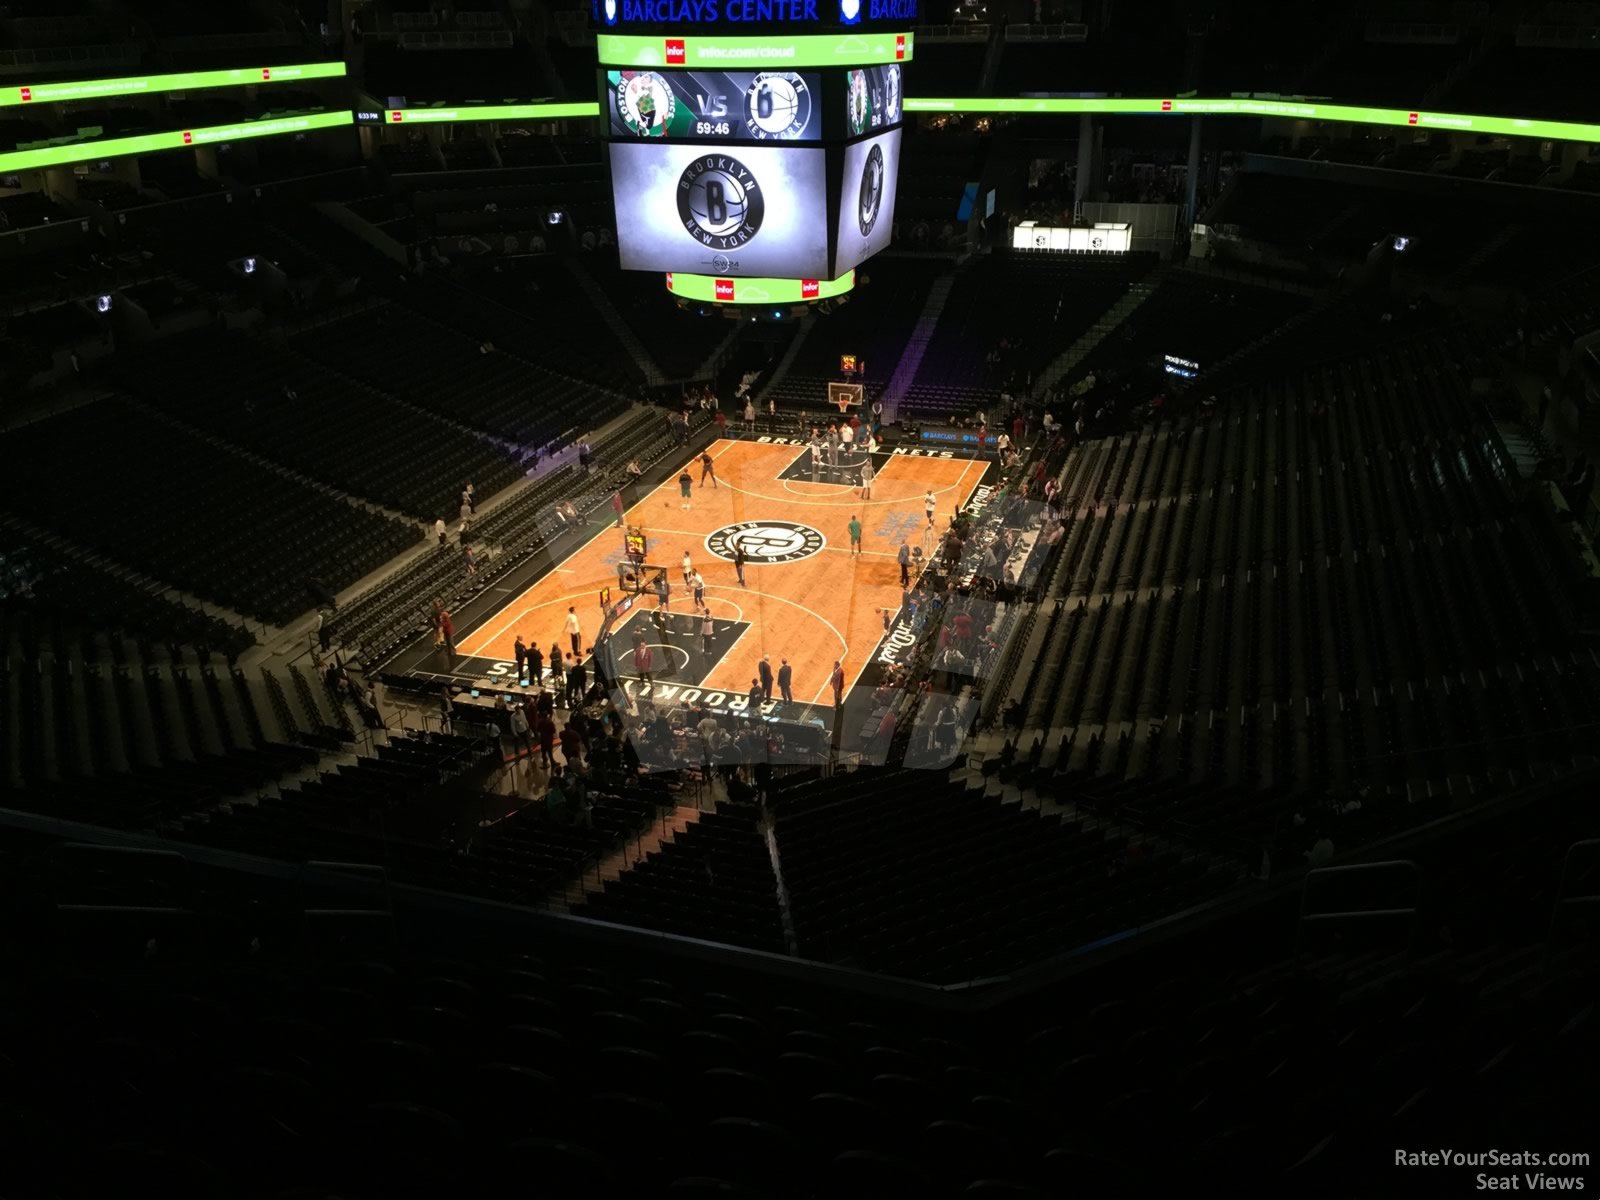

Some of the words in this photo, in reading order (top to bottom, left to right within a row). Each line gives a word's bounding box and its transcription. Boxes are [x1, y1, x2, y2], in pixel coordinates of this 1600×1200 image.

[623, 0, 718, 22] BARCLAYS
[726, 0, 819, 21] CENTER
[666, 46, 684, 55] infor
[618, 78, 634, 122] BOSTON
[697, 94, 728, 117] VS
[697, 122, 730, 135] 59:46
[747, 119, 767, 139] NEW
[681, 157, 756, 191] BROOKLYN
[686, 219, 713, 245] NEW
[720, 223, 755, 248] YORK
[716, 284, 734, 294] infor
[802, 283, 819, 292] infor
[892, 447, 954, 459] NETS
[628, 541, 643, 554] 24
